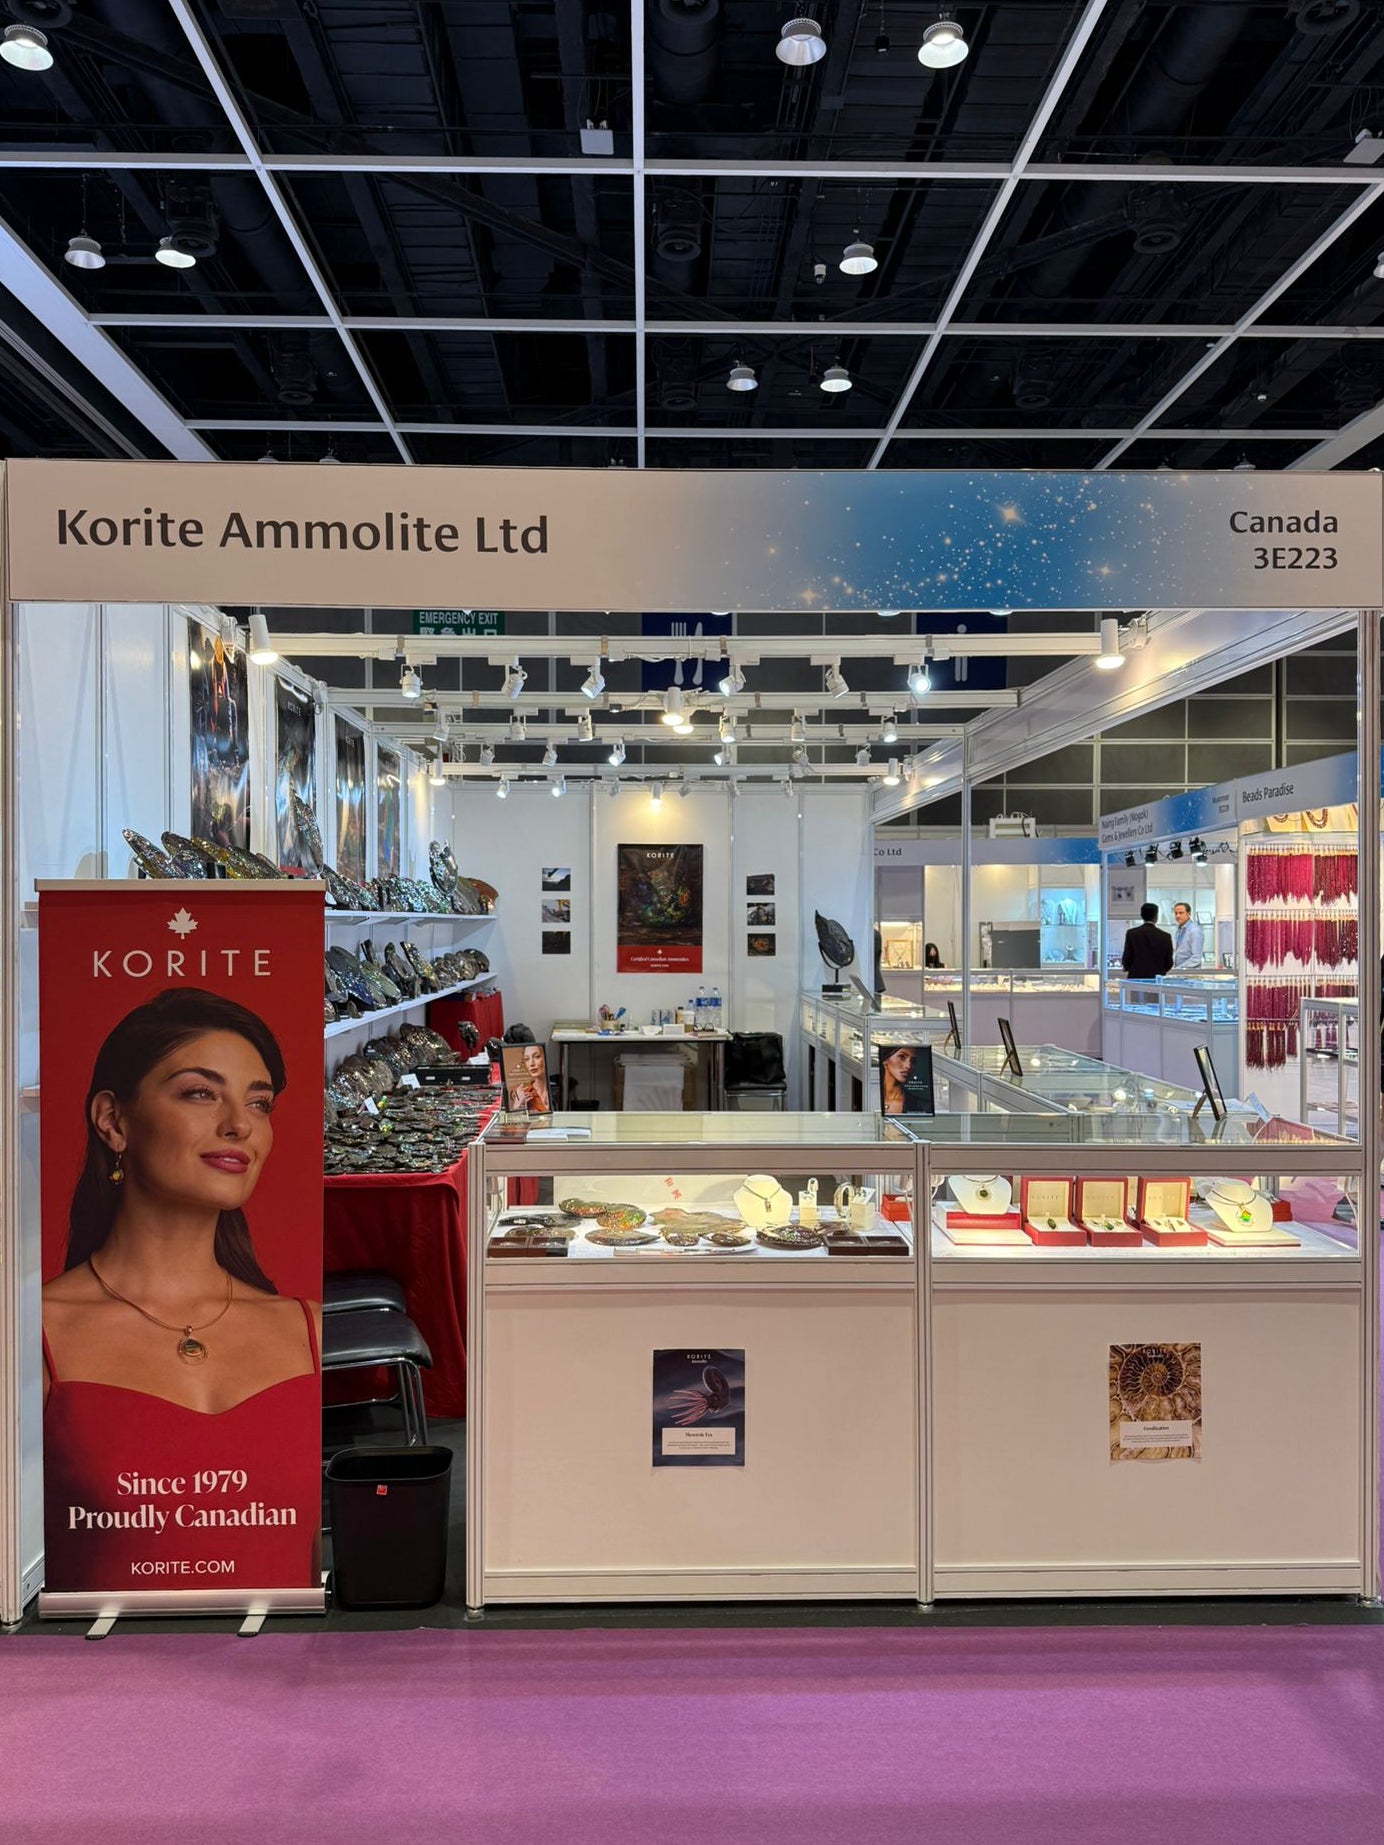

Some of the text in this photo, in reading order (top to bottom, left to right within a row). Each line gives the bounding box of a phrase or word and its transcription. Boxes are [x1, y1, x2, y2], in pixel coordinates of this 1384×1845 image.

[57, 507, 548, 554] Korite Ammolite Ltd
[1229, 509, 1338, 534] Canada
[1254, 547, 1338, 570] 3E223
[419, 611, 498, 624] EMERGENCY EXIT
[1242, 782, 1295, 804] Beads Paradise
[1114, 813, 1129, 827] Family
[1101, 833, 1114, 843] Gems
[1117, 827, 1137, 841] Jewellery
[1137, 825, 1144, 835] Co
[1145, 822, 1153, 834] Ltd
[887, 847, 902, 856] Ltd
[93, 949, 271, 978] KORITE
[117, 1469, 248, 1495] Since 1979
[68, 1501, 297, 1535] Proudly Canadian
[131, 1560, 236, 1575] KORITE.COM
